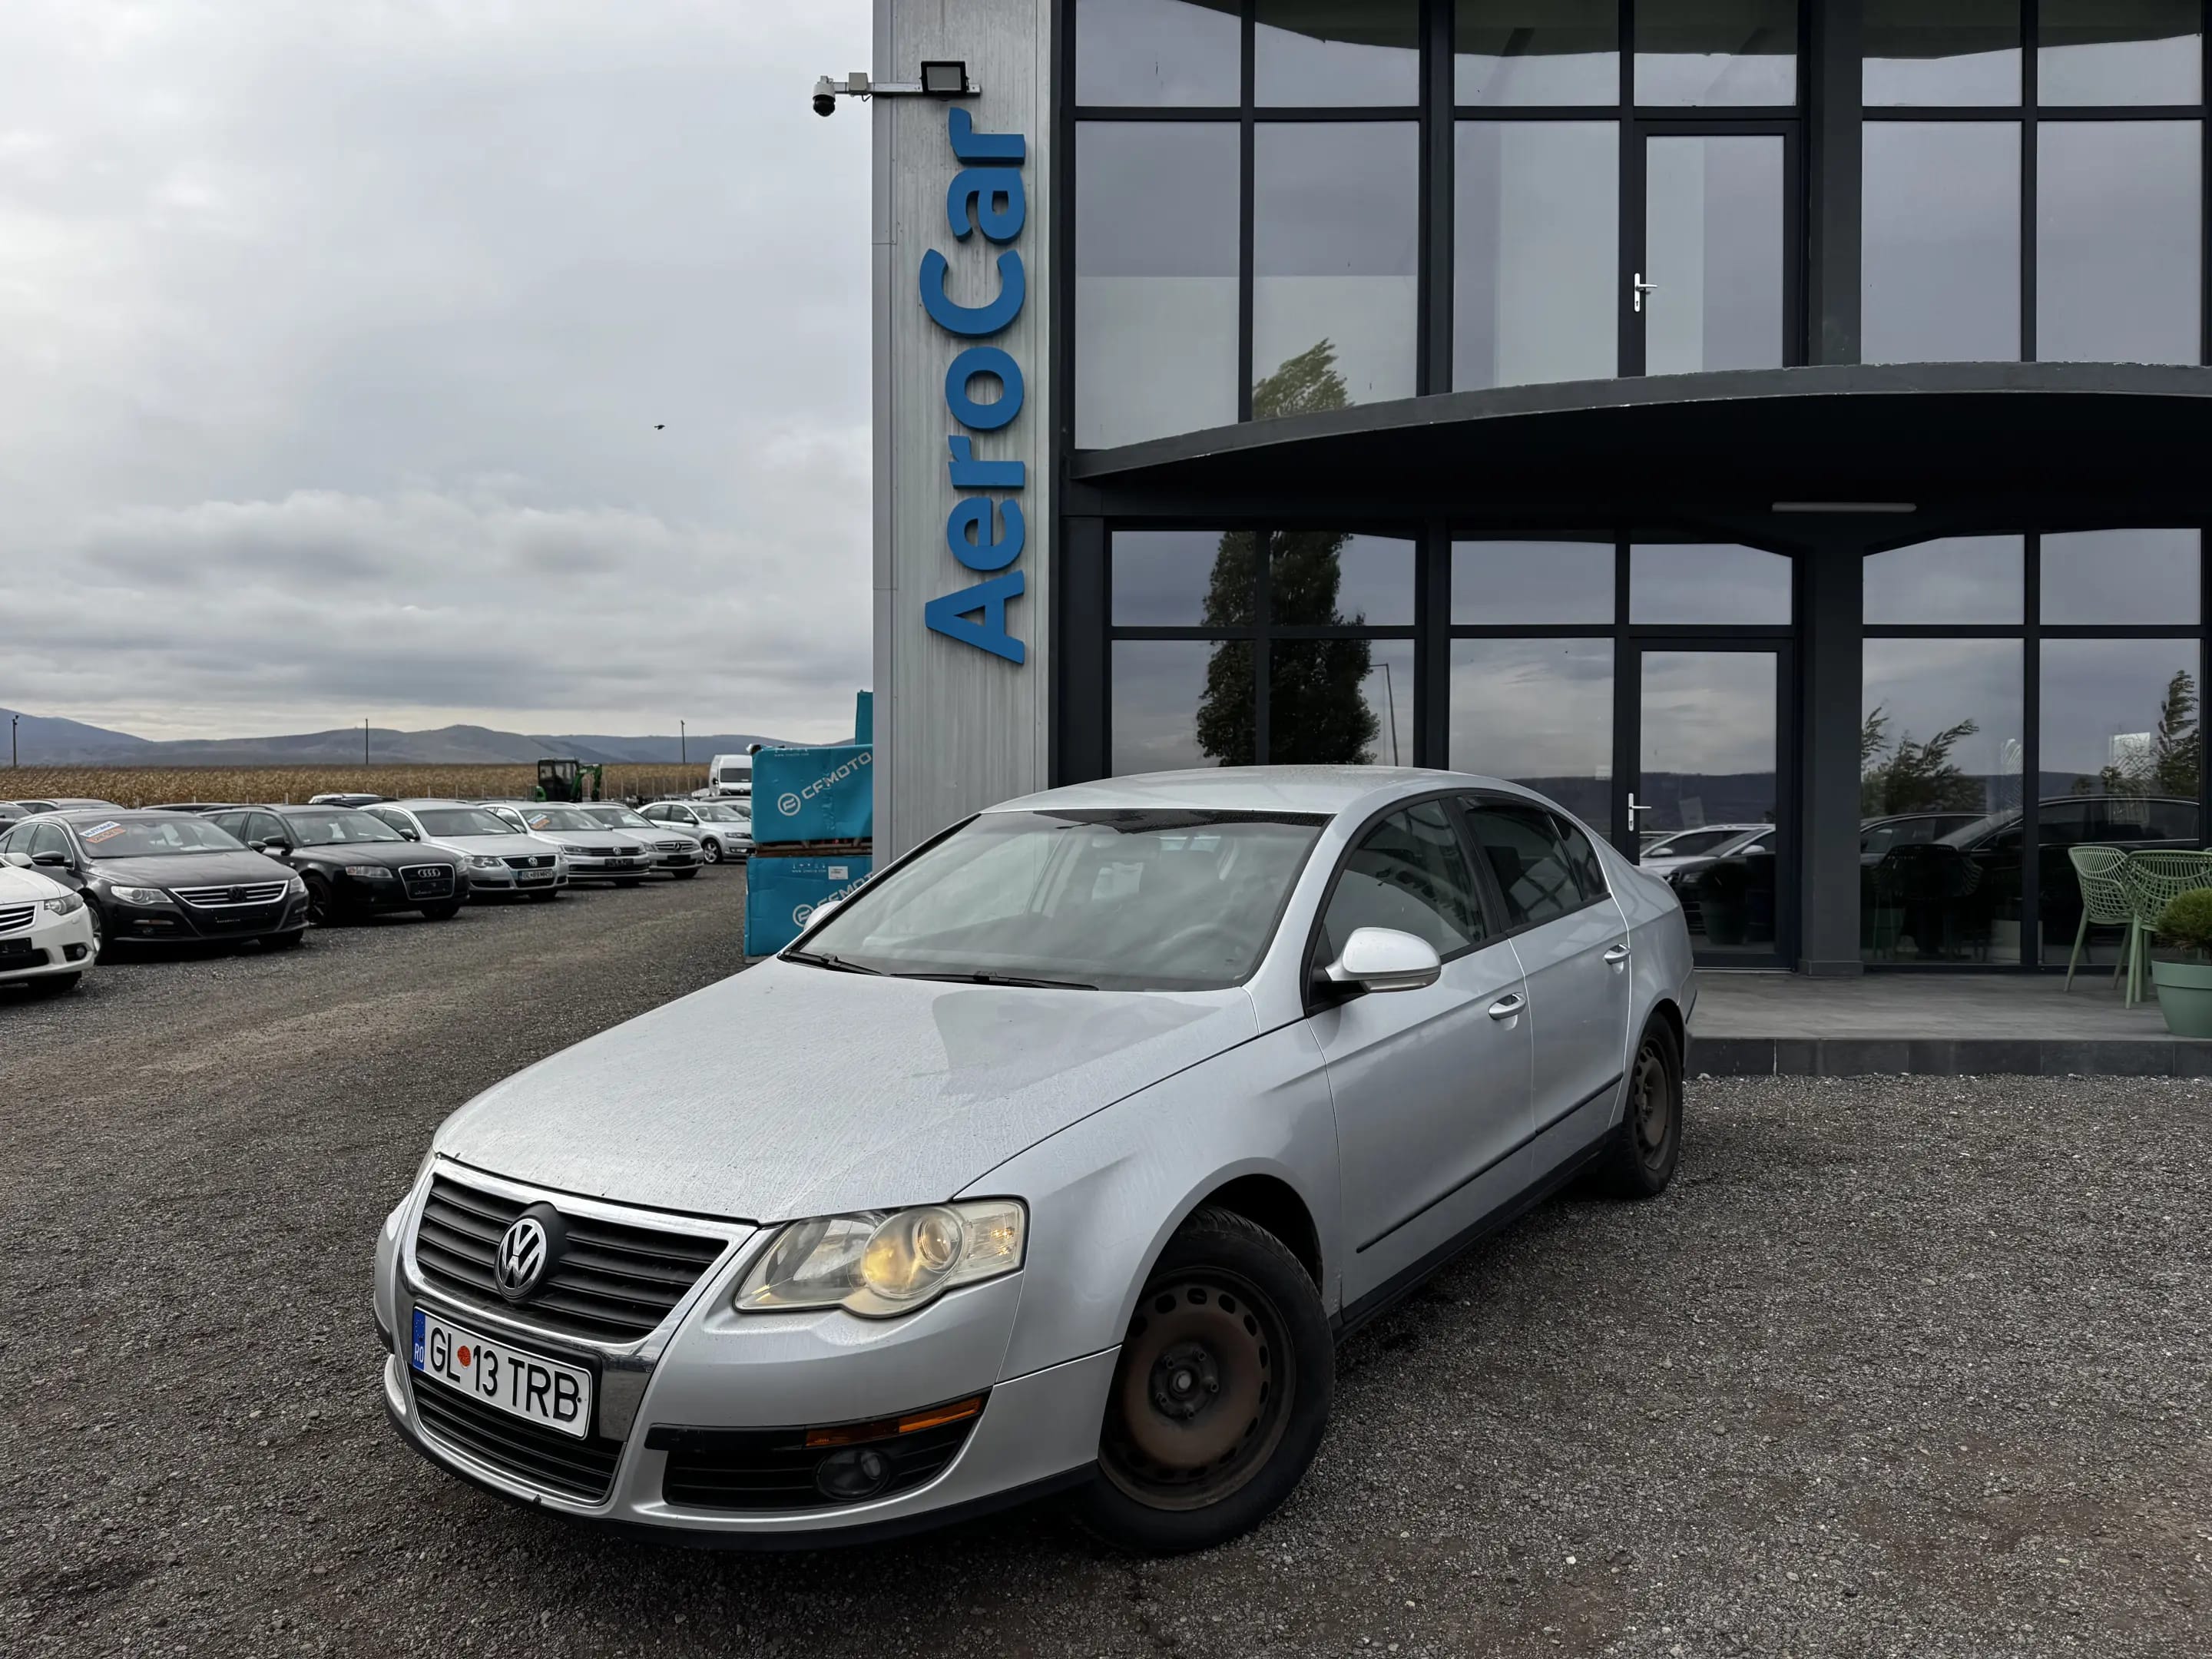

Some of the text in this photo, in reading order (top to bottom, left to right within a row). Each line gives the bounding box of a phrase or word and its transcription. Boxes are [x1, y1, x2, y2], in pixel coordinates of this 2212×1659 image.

[919, 107, 1026, 665] AeroCar
[801, 752, 872, 800] CFMOTO
[414, 1343, 425, 1363] RO
[430, 1326, 580, 1422] GL 13 TRB
